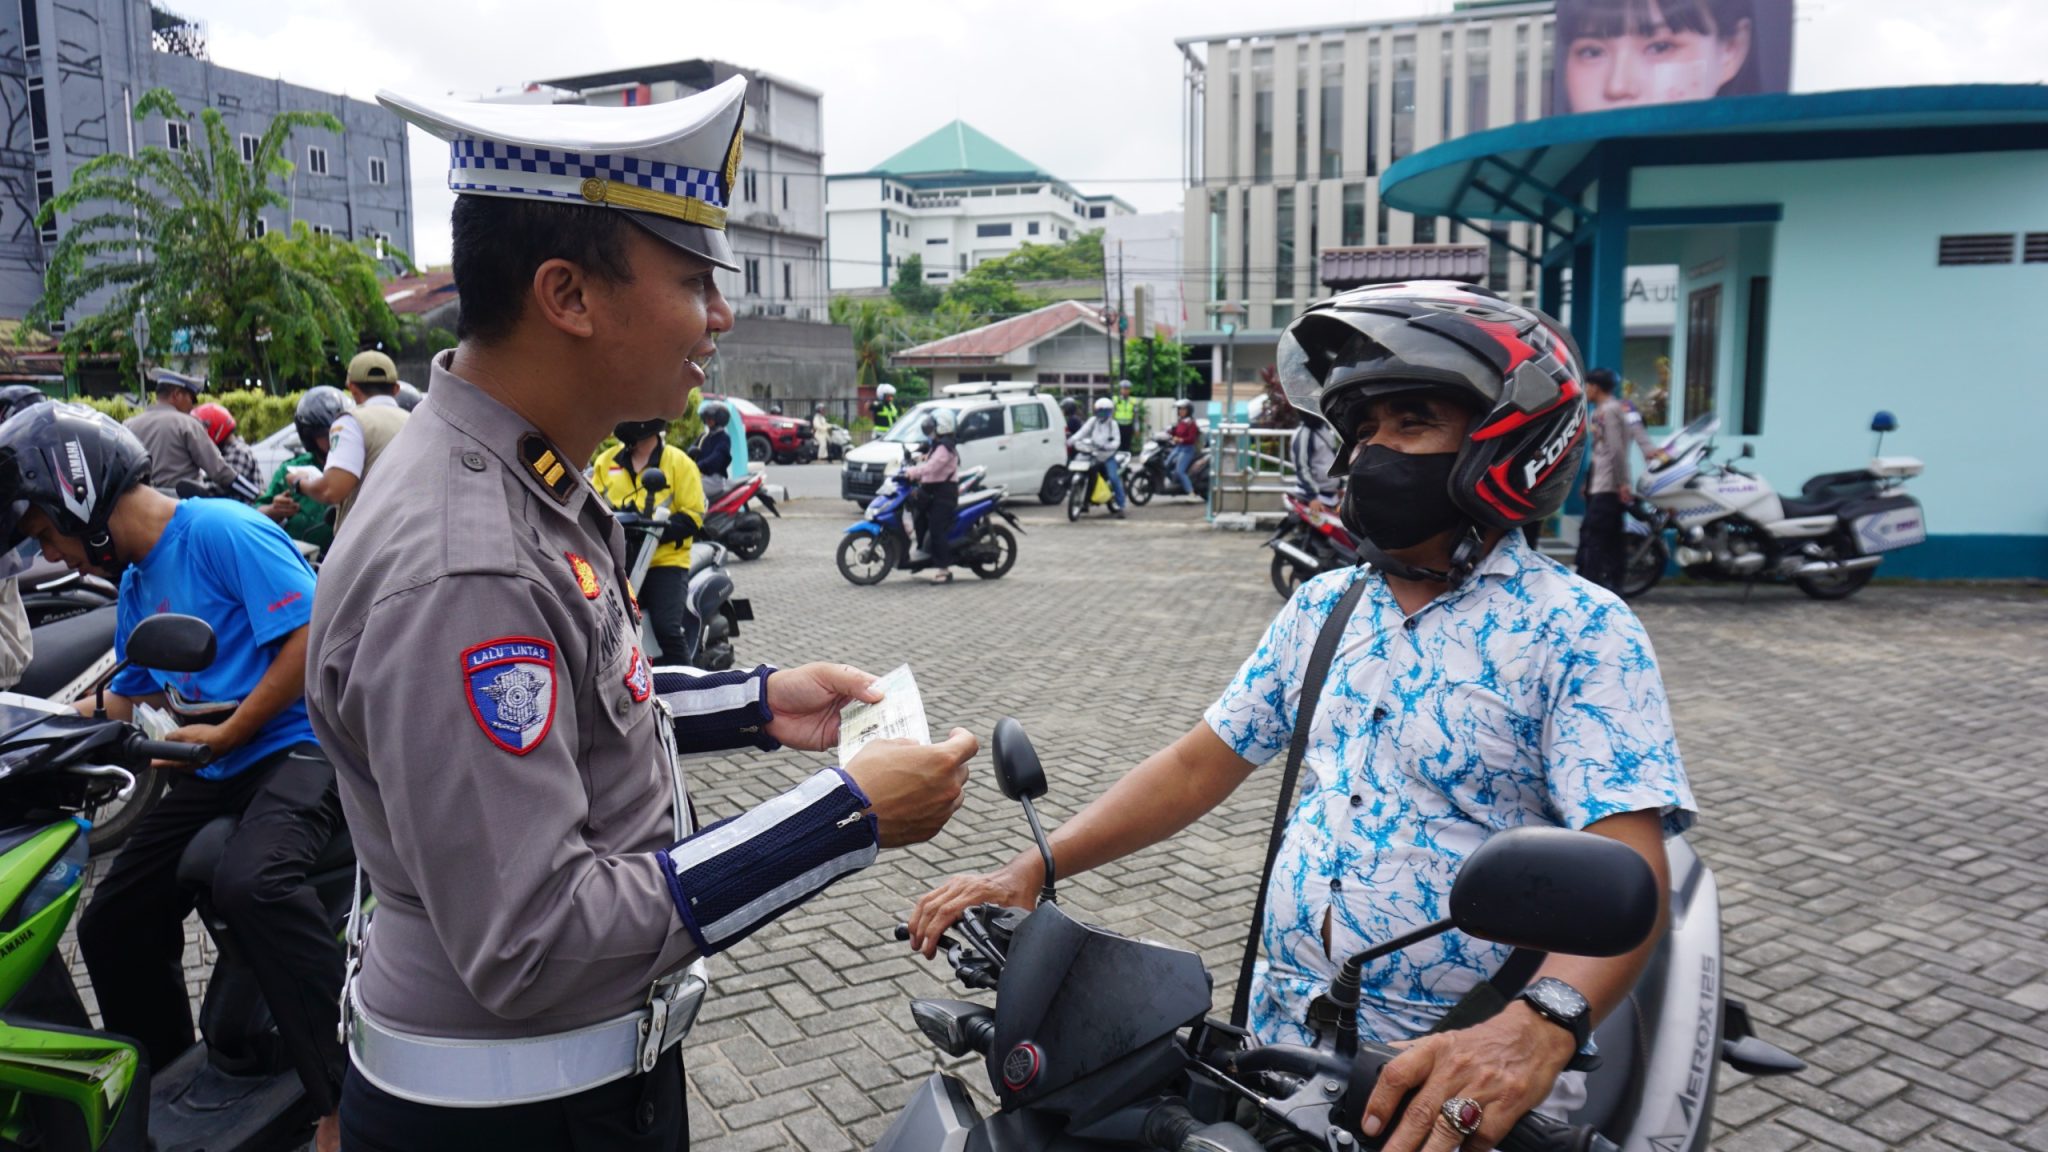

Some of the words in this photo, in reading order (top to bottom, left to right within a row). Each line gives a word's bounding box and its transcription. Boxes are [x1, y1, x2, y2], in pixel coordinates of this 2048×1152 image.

[65, 441, 84, 480] YAMAHA
[473, 648, 504, 665] LALU
[511, 645, 546, 660] LINTAS
[0, 929, 35, 959] AMAHA
[1677, 1006, 1713, 1129] AEROX
[1700, 954, 1716, 1000] 125
